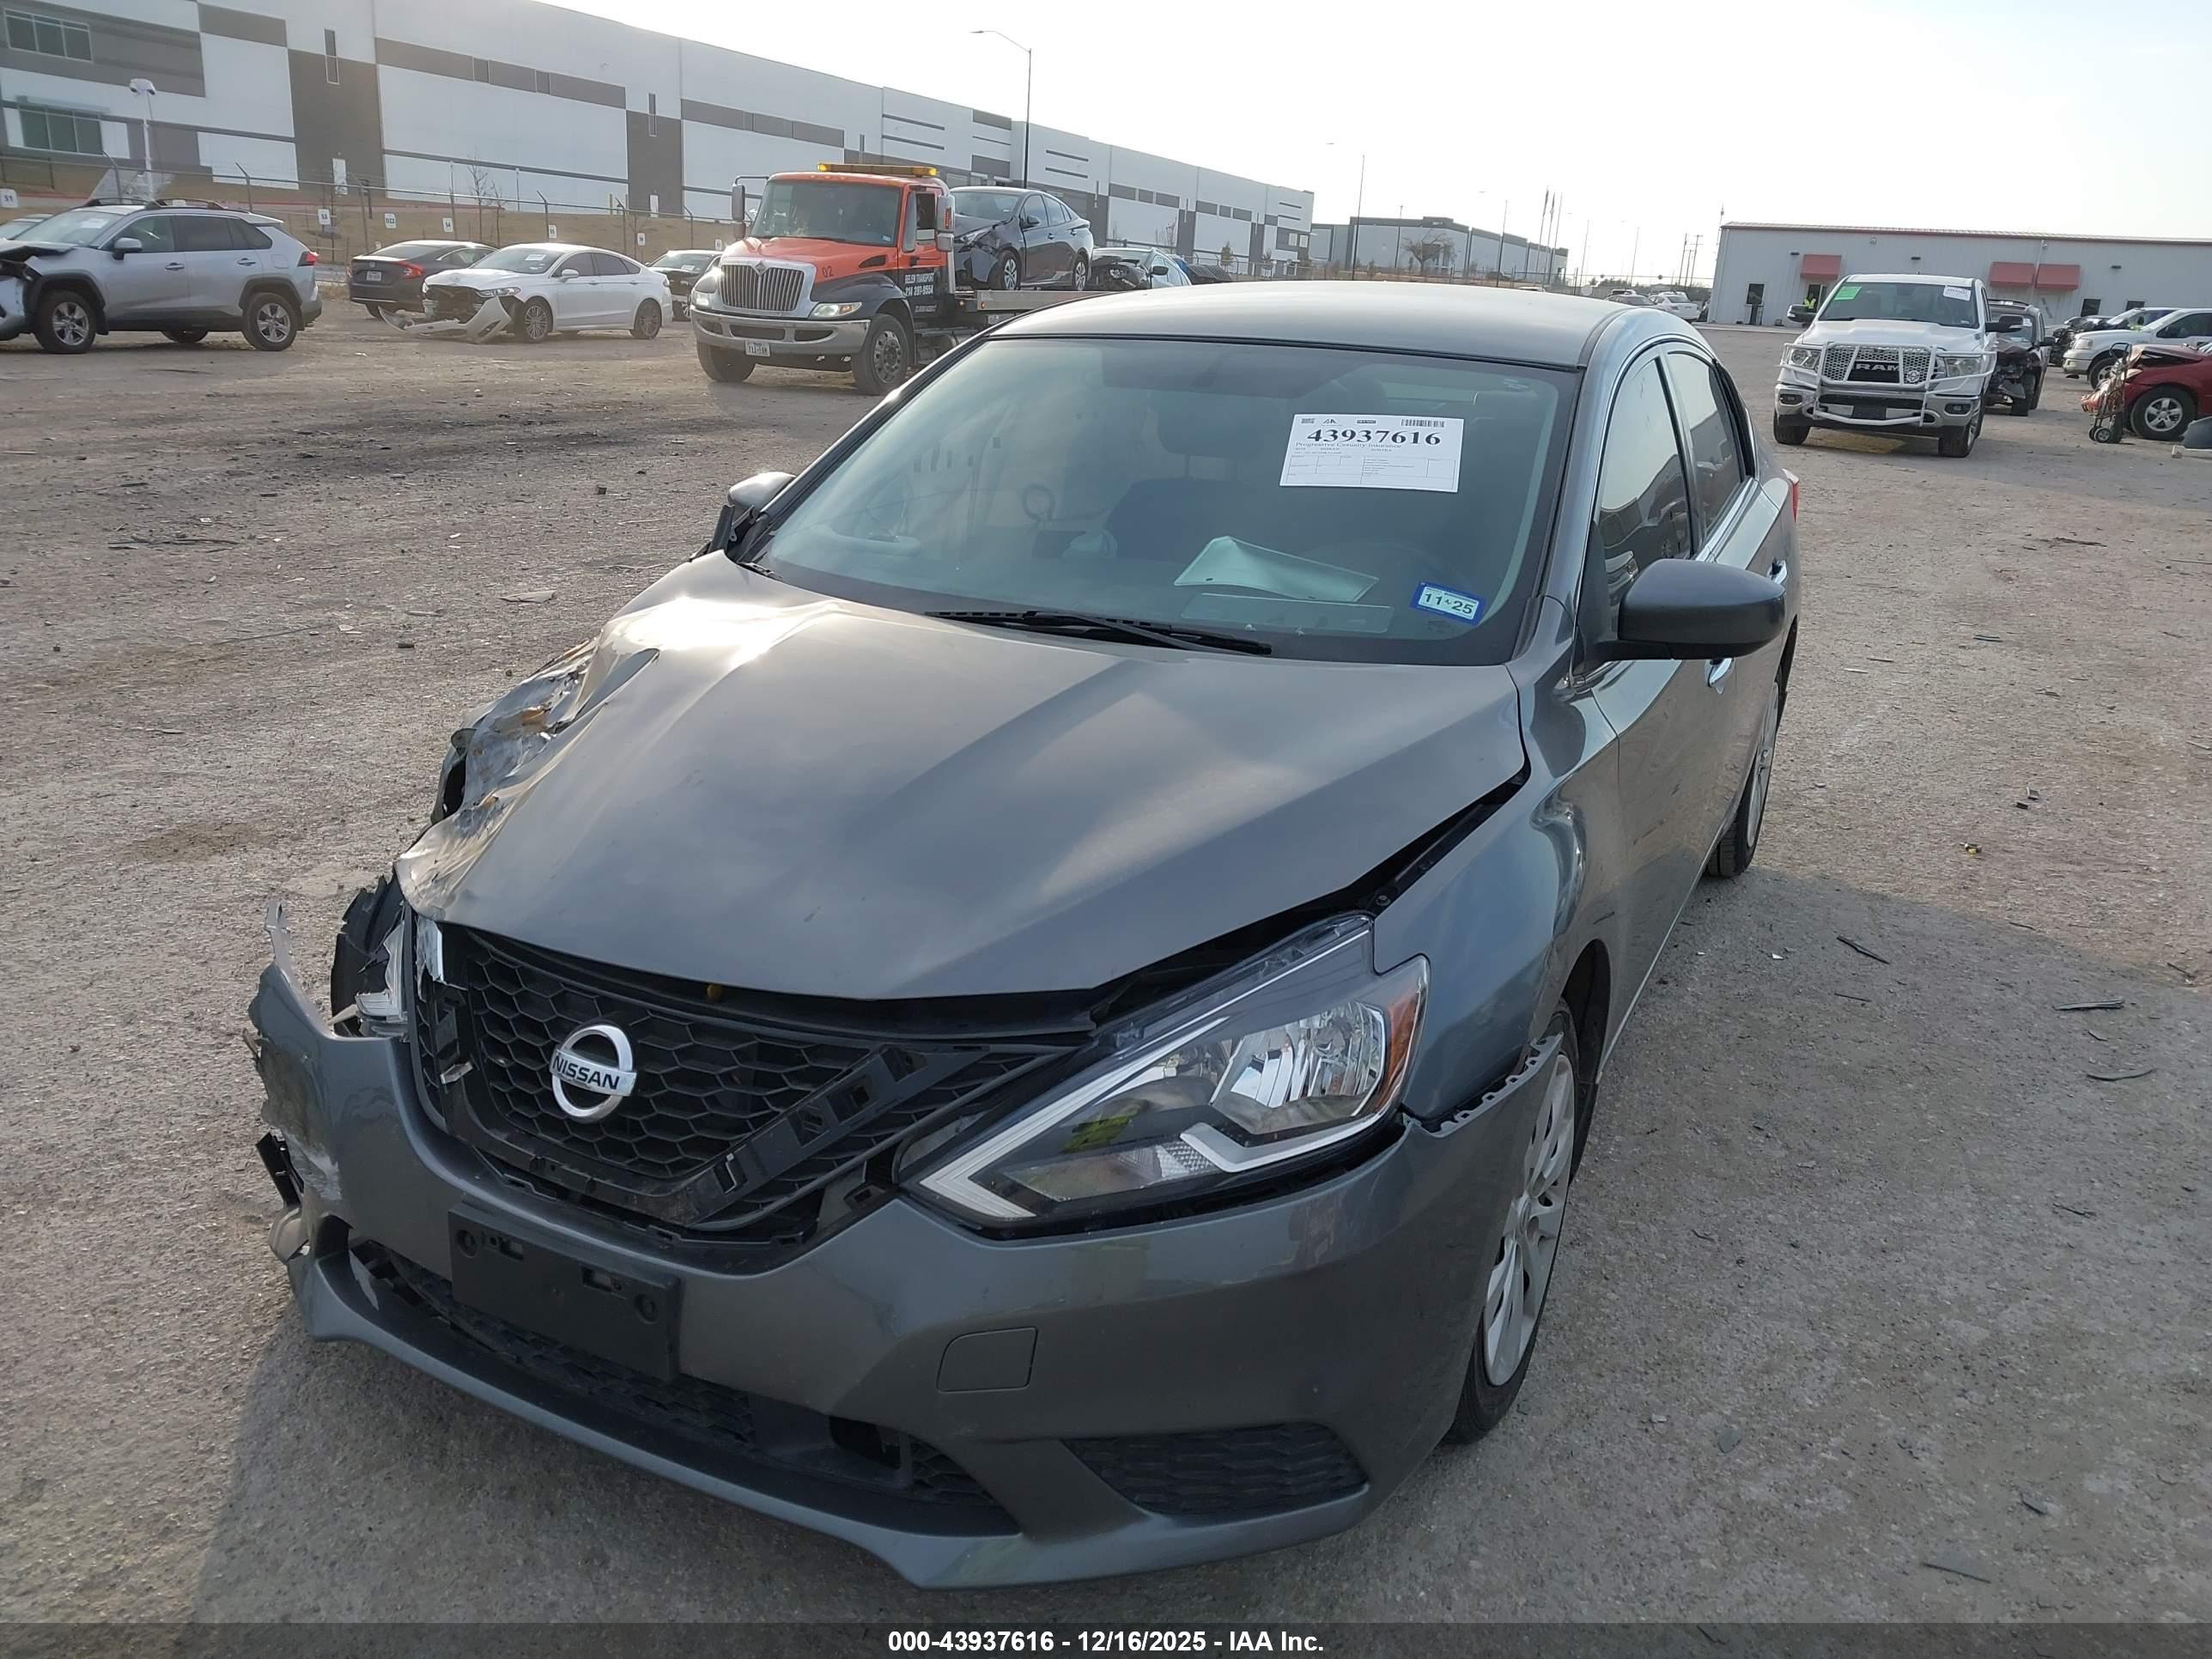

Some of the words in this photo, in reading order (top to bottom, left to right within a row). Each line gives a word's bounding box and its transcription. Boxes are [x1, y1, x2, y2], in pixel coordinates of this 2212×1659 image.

[905, 275, 915, 284] BELEN
[916, 272, 935, 283] TRANSPORT
[1306, 428, 1442, 445] 43937616
[552, 1055, 620, 1091] NISSAN
